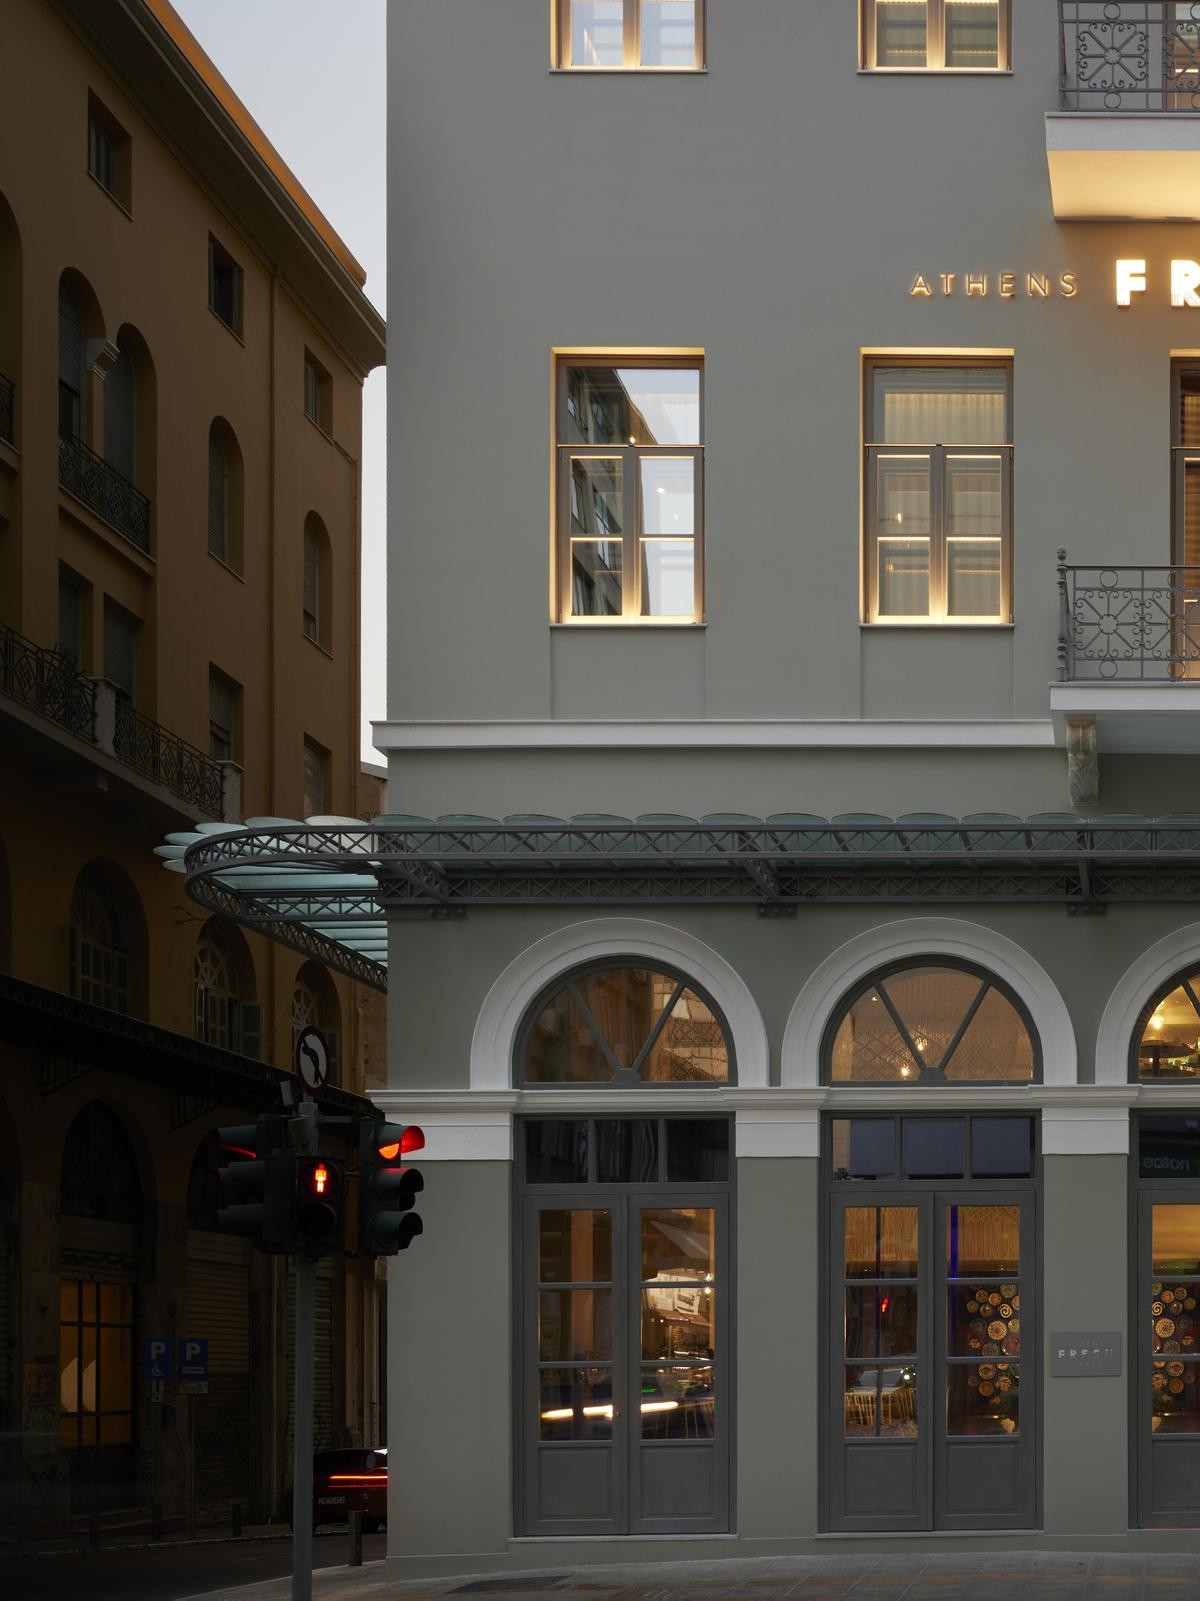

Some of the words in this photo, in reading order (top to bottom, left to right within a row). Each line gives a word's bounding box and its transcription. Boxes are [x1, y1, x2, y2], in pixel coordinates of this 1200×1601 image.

[910, 273, 1077, 297] ATHENS
[151, 1341, 166, 1361] P
[186, 1342, 201, 1361] P
